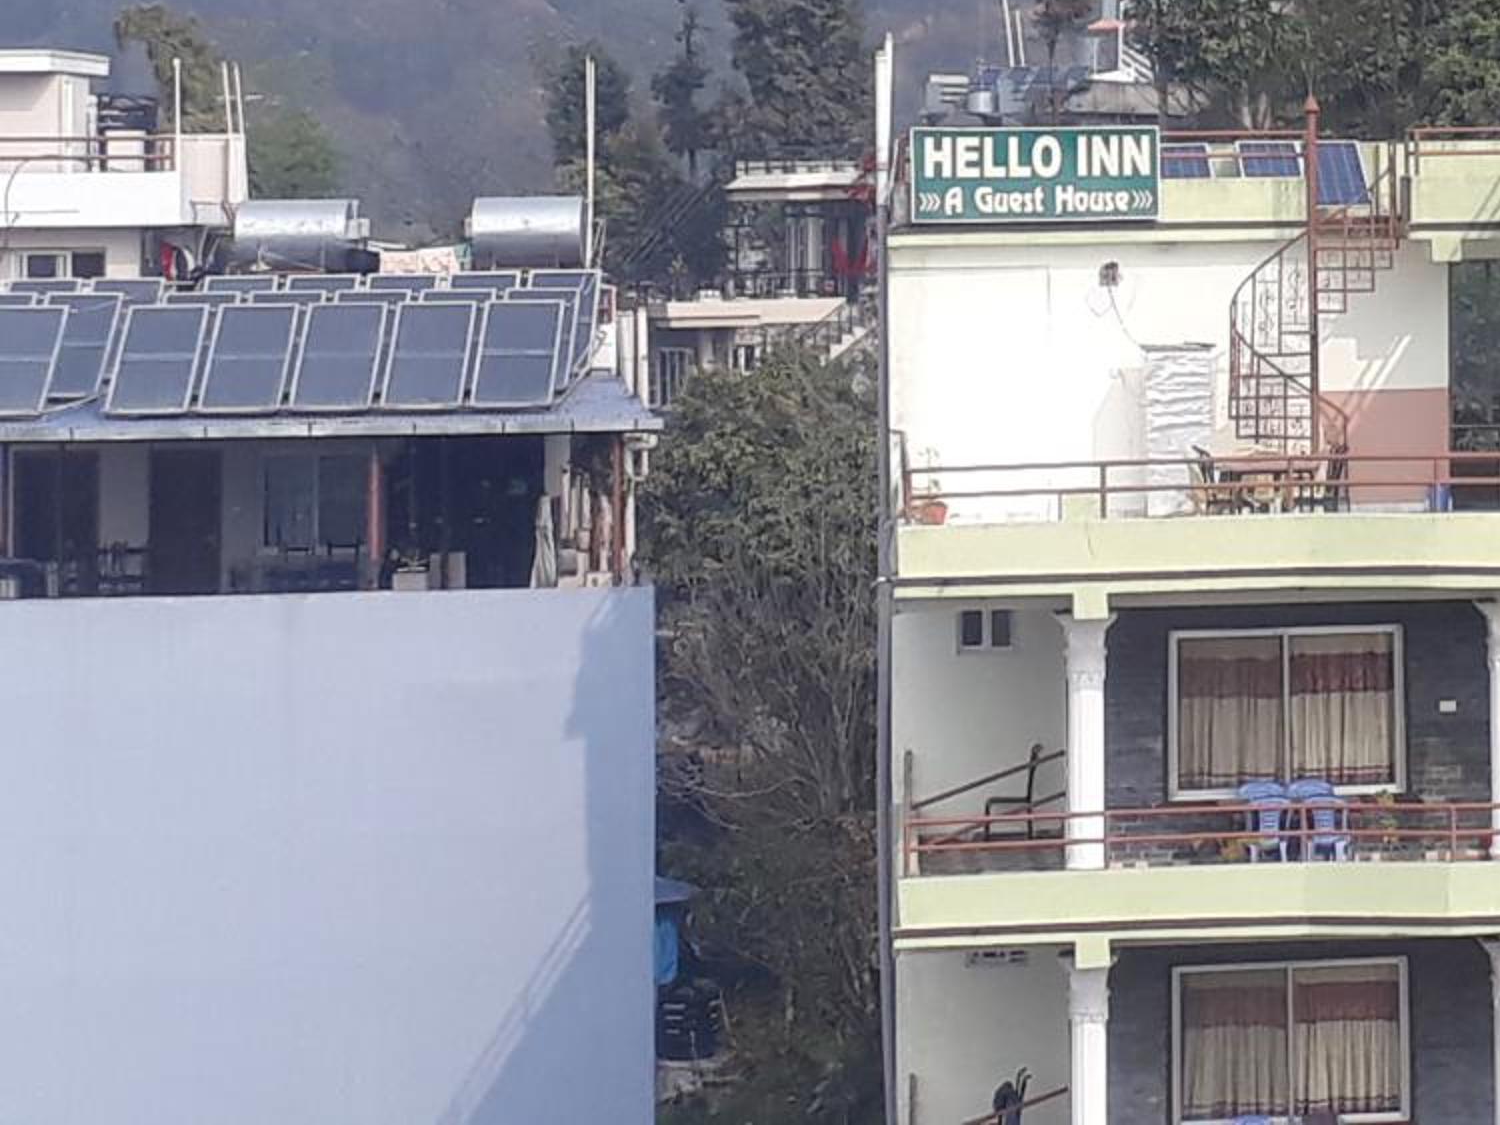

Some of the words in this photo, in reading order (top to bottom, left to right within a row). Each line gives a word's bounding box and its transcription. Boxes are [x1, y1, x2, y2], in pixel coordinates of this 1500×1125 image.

[922, 134, 1063, 179] HELLO
[1075, 133, 1151, 178] INN
[944, 186, 964, 216] A
[973, 186, 1045, 214] Guest
[1054, 184, 1131, 215] House
